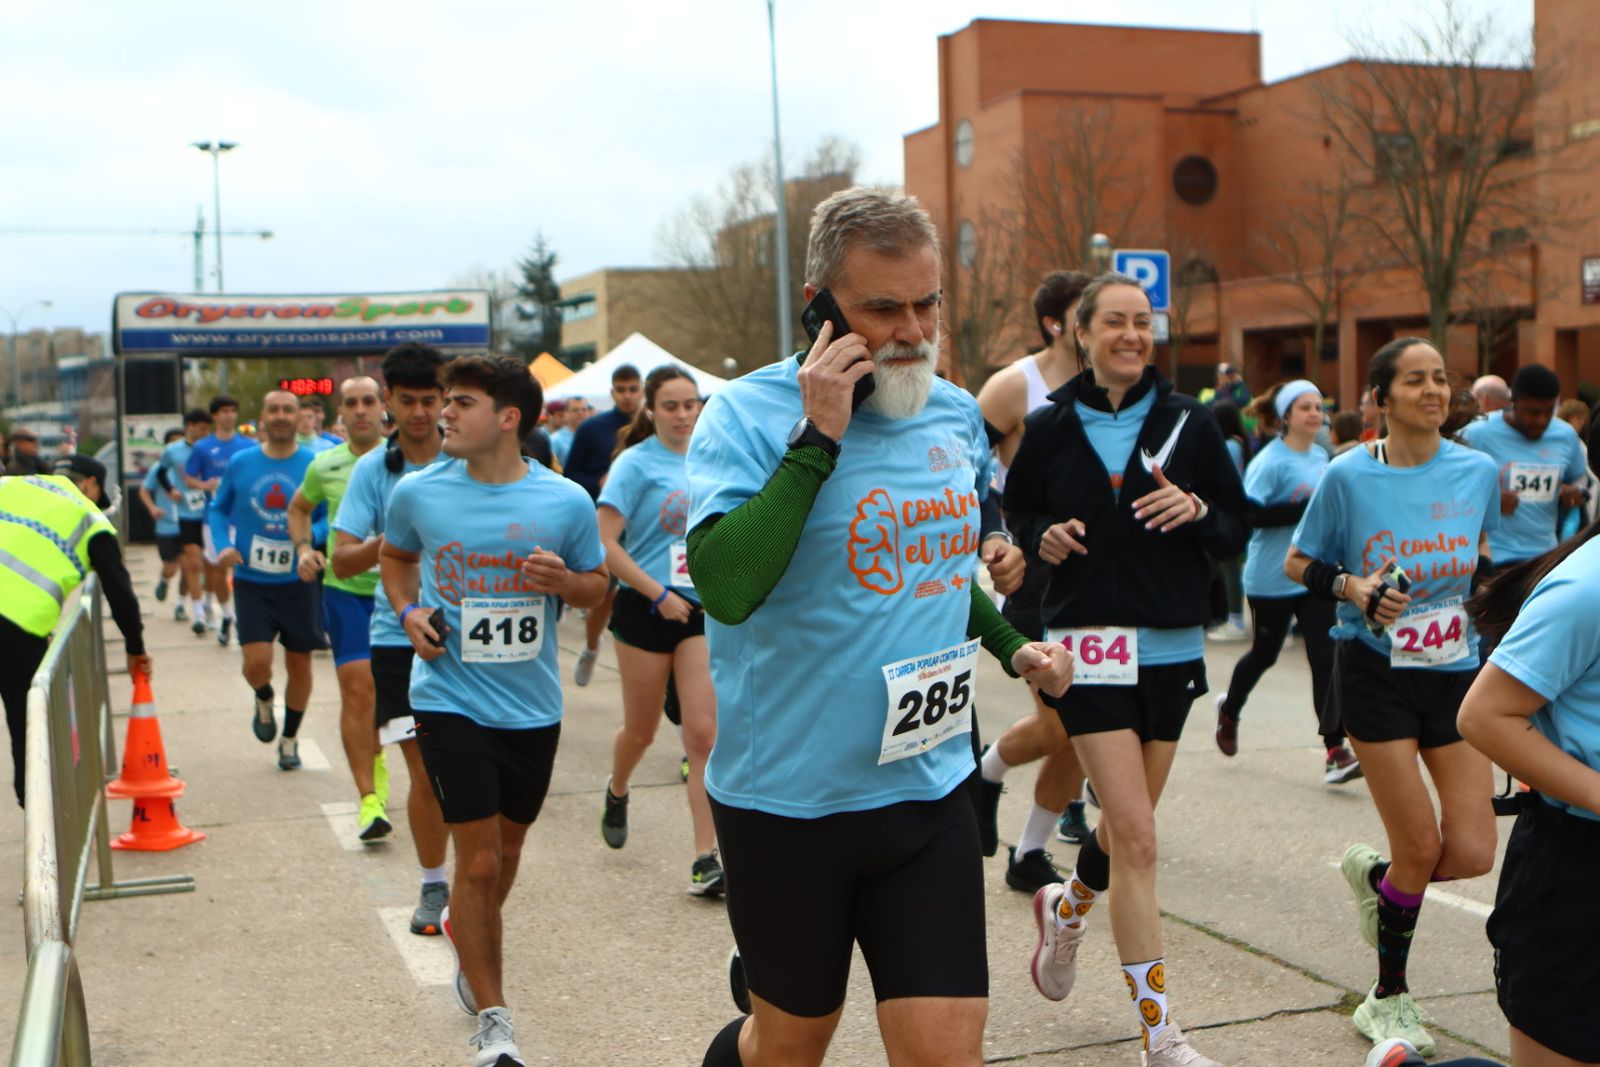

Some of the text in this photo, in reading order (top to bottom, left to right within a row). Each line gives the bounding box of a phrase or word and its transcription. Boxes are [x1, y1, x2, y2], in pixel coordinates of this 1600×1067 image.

[1126, 257, 1159, 289] P
[171, 328, 443, 347] www.orycronsport.com
[1515, 474, 1552, 491] 341
[255, 547, 290, 565] 118
[905, 533, 934, 565] el
[1400, 532, 1469, 558] contra
[467, 550, 524, 570] contr
[468, 575, 490, 593] el
[469, 616, 538, 645] 418
[1396, 614, 1462, 653] 244
[1060, 635, 1131, 665] 164
[892, 669, 972, 737] 285
